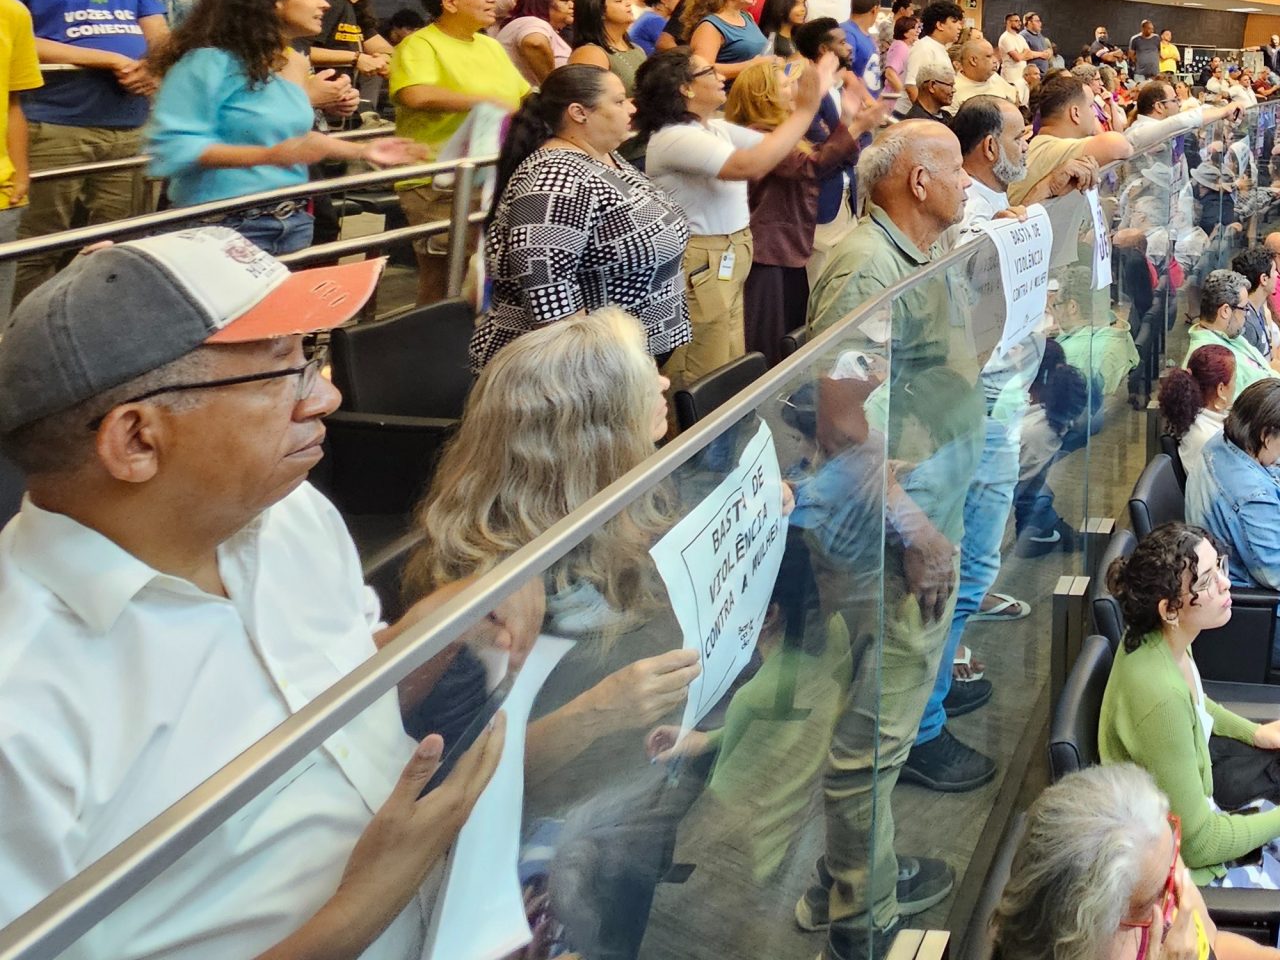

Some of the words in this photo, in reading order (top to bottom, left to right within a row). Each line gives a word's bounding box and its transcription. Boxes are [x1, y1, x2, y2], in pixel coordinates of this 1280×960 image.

[63, 8, 114, 23] VOZES
[1009, 226, 1032, 246] BASTA
[751, 464, 764, 498] DE
[709, 502, 768, 604] VIOLÊNCIA
[704, 592, 736, 659] CONTRA
[741, 573, 749, 594] A
